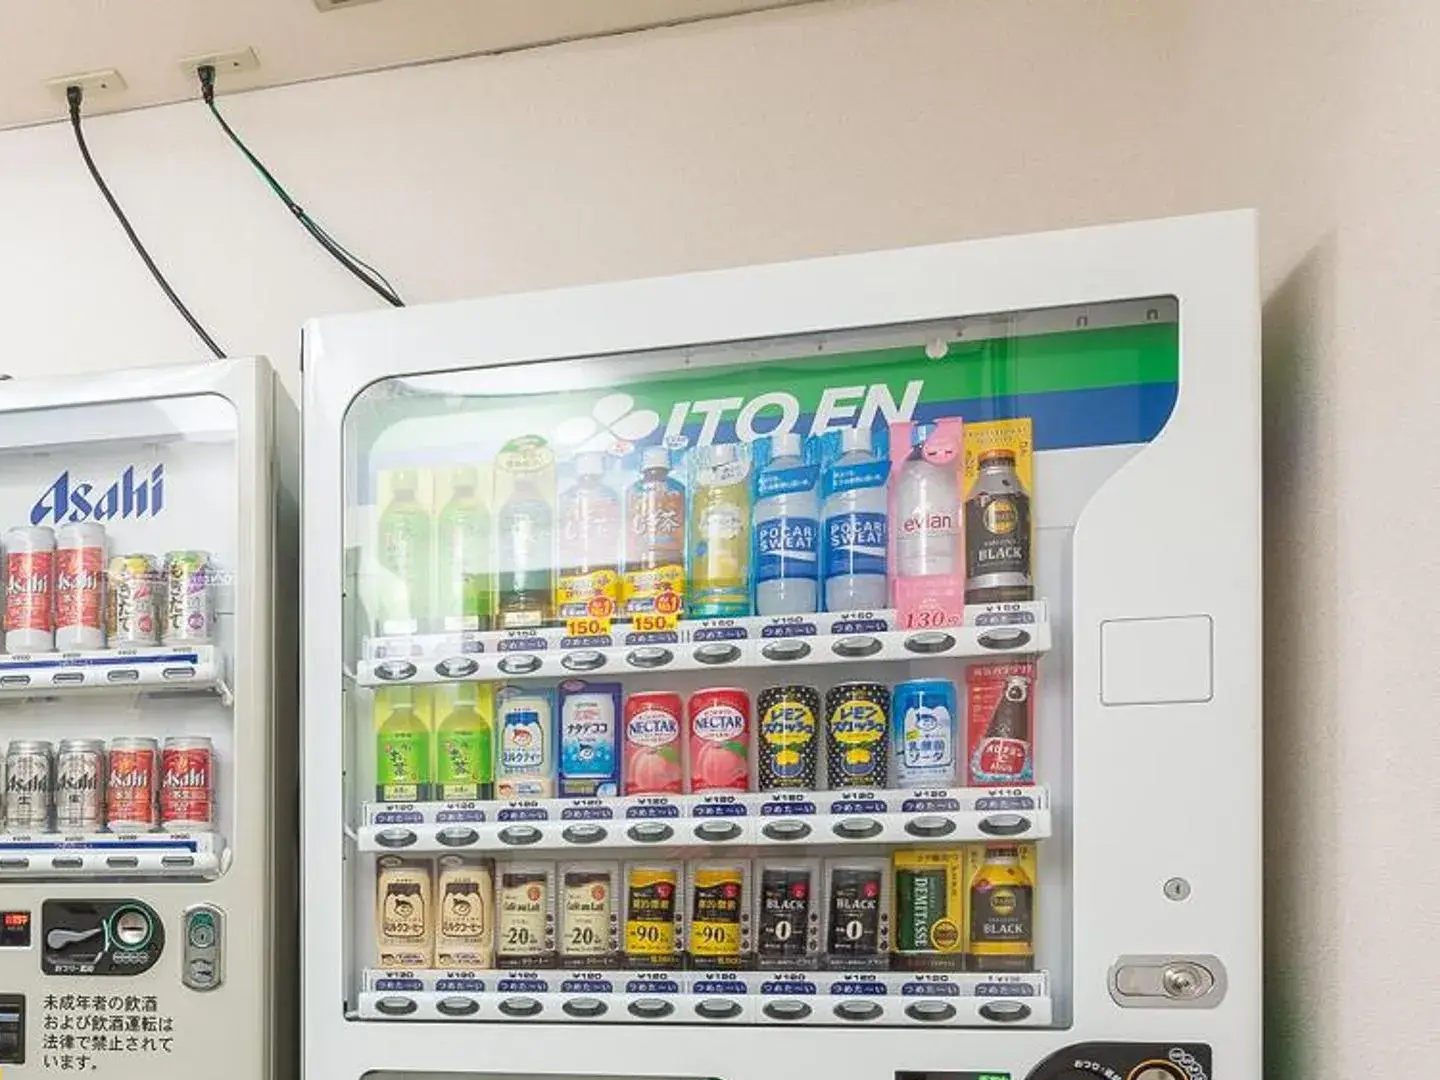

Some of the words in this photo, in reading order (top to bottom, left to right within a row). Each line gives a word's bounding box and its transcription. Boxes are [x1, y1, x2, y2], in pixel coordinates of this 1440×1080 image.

[663, 390, 800, 449] ITO
[810, 380, 925, 438] EN
[30, 463, 164, 525] Asahi
[830, 520, 887, 536] POCARI
[903, 514, 952, 533] evian
[759, 536, 812, 552] SWEAT
[830, 531, 882, 548] SWEAT
[978, 546, 1023, 562] BLACK
[771, 707, 805, 721] レモン
[839, 706, 879, 720] レモン
[566, 722, 608, 735] ナタデココ
[629, 720, 677, 735] NECTAR
[695, 716, 743, 730] NECTAR
[162, 767, 205, 788] Asahi
[766, 898, 805, 910] BLACK
[836, 898, 877, 910] BLACK
[913, 876, 929, 948] DEMITASSE
[508, 927, 530, 945] 20
[571, 926, 594, 945] 20
[635, 925, 660, 943] 90
[702, 925, 726, 943] 90
[775, 920, 792, 940] 0
[846, 920, 863, 940] 0
[983, 922, 1024, 935] BLACK
[42, 994, 159, 1012] 未成年者の飲酒
[42, 1015, 175, 1033] および飲酒運転は
[42, 1035, 175, 1053] 法律で禁止されて
[42, 1054, 98, 1071] います。
